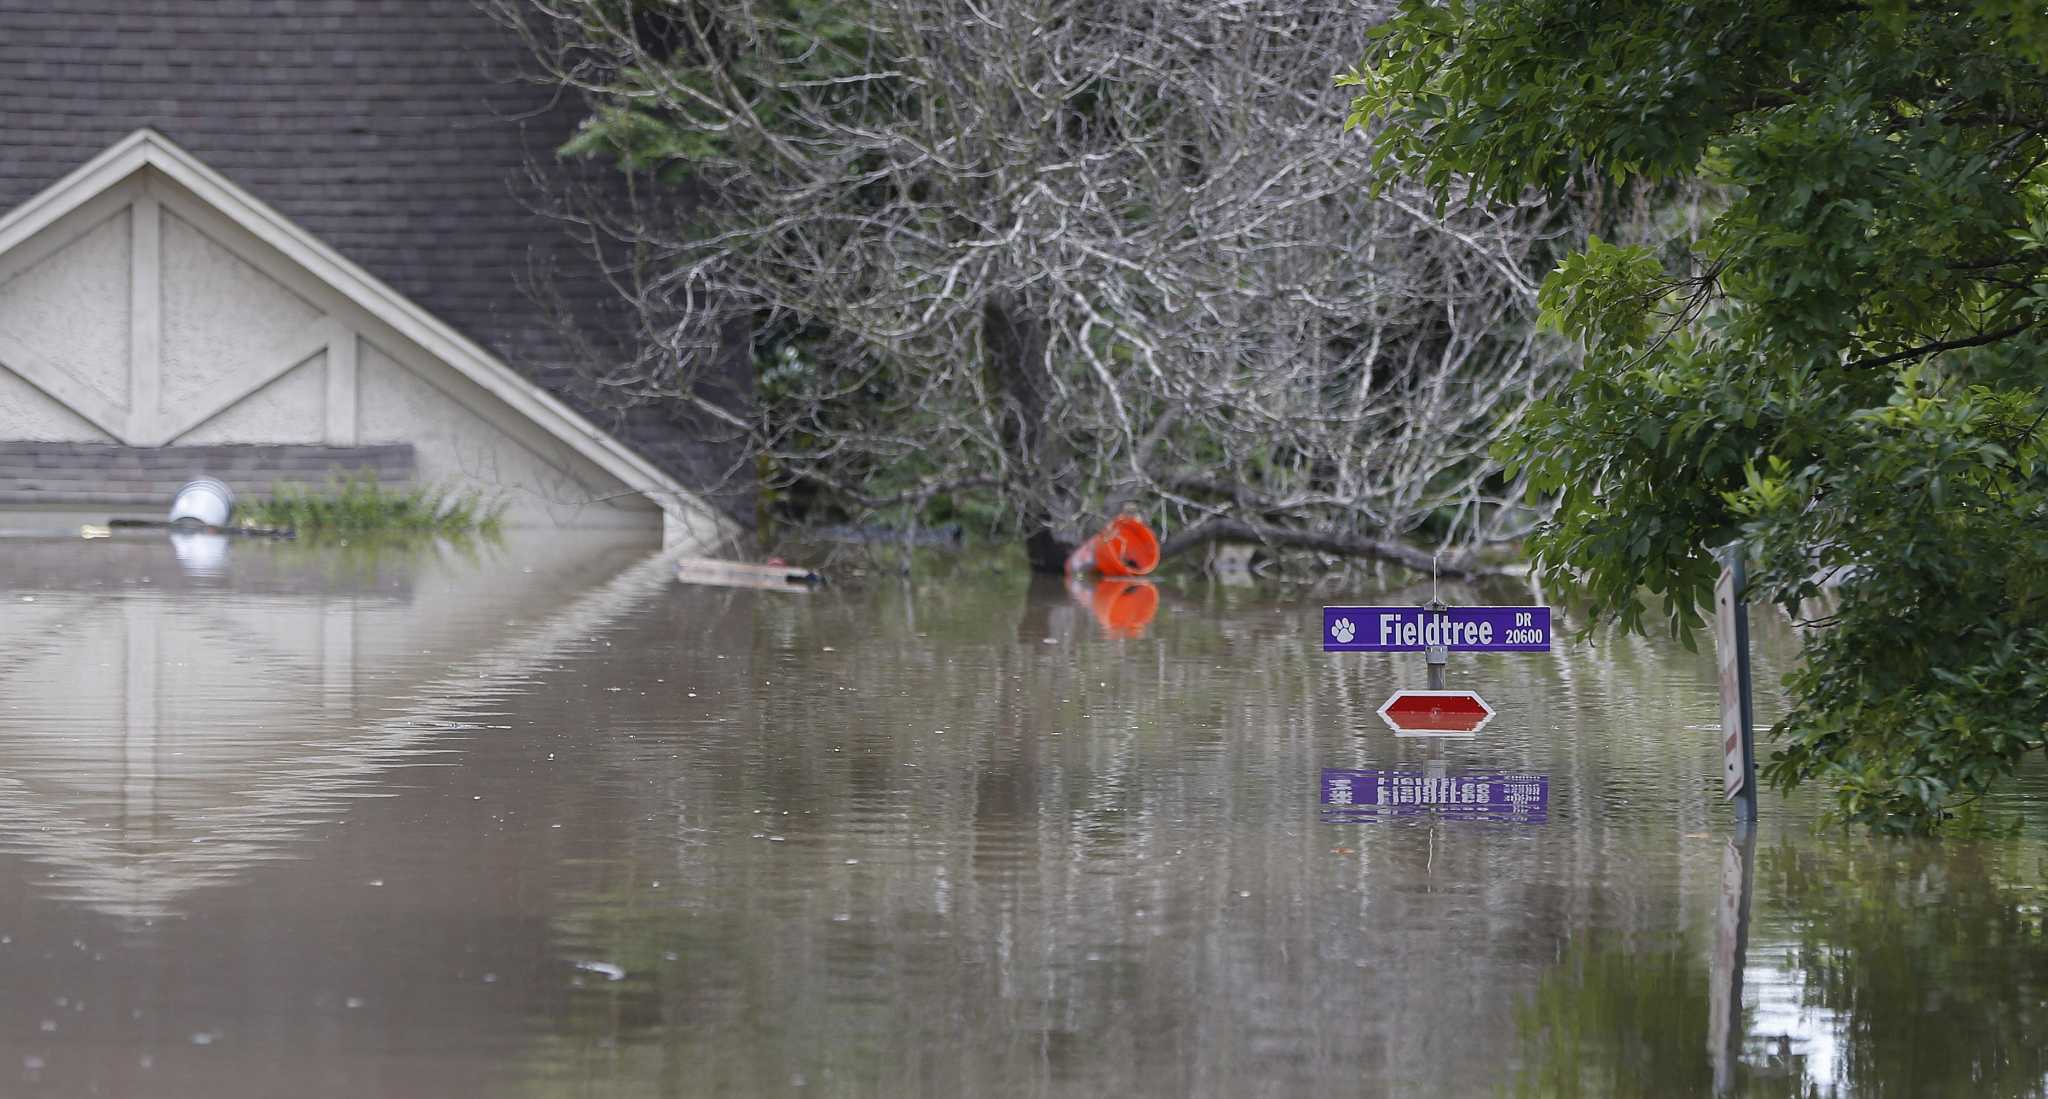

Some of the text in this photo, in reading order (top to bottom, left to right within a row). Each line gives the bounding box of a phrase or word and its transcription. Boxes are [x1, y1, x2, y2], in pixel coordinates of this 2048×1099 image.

[1515, 612, 1532, 627] DR
[1379, 613, 1493, 646] Fieldtree
[1505, 629, 1543, 644] 20600
